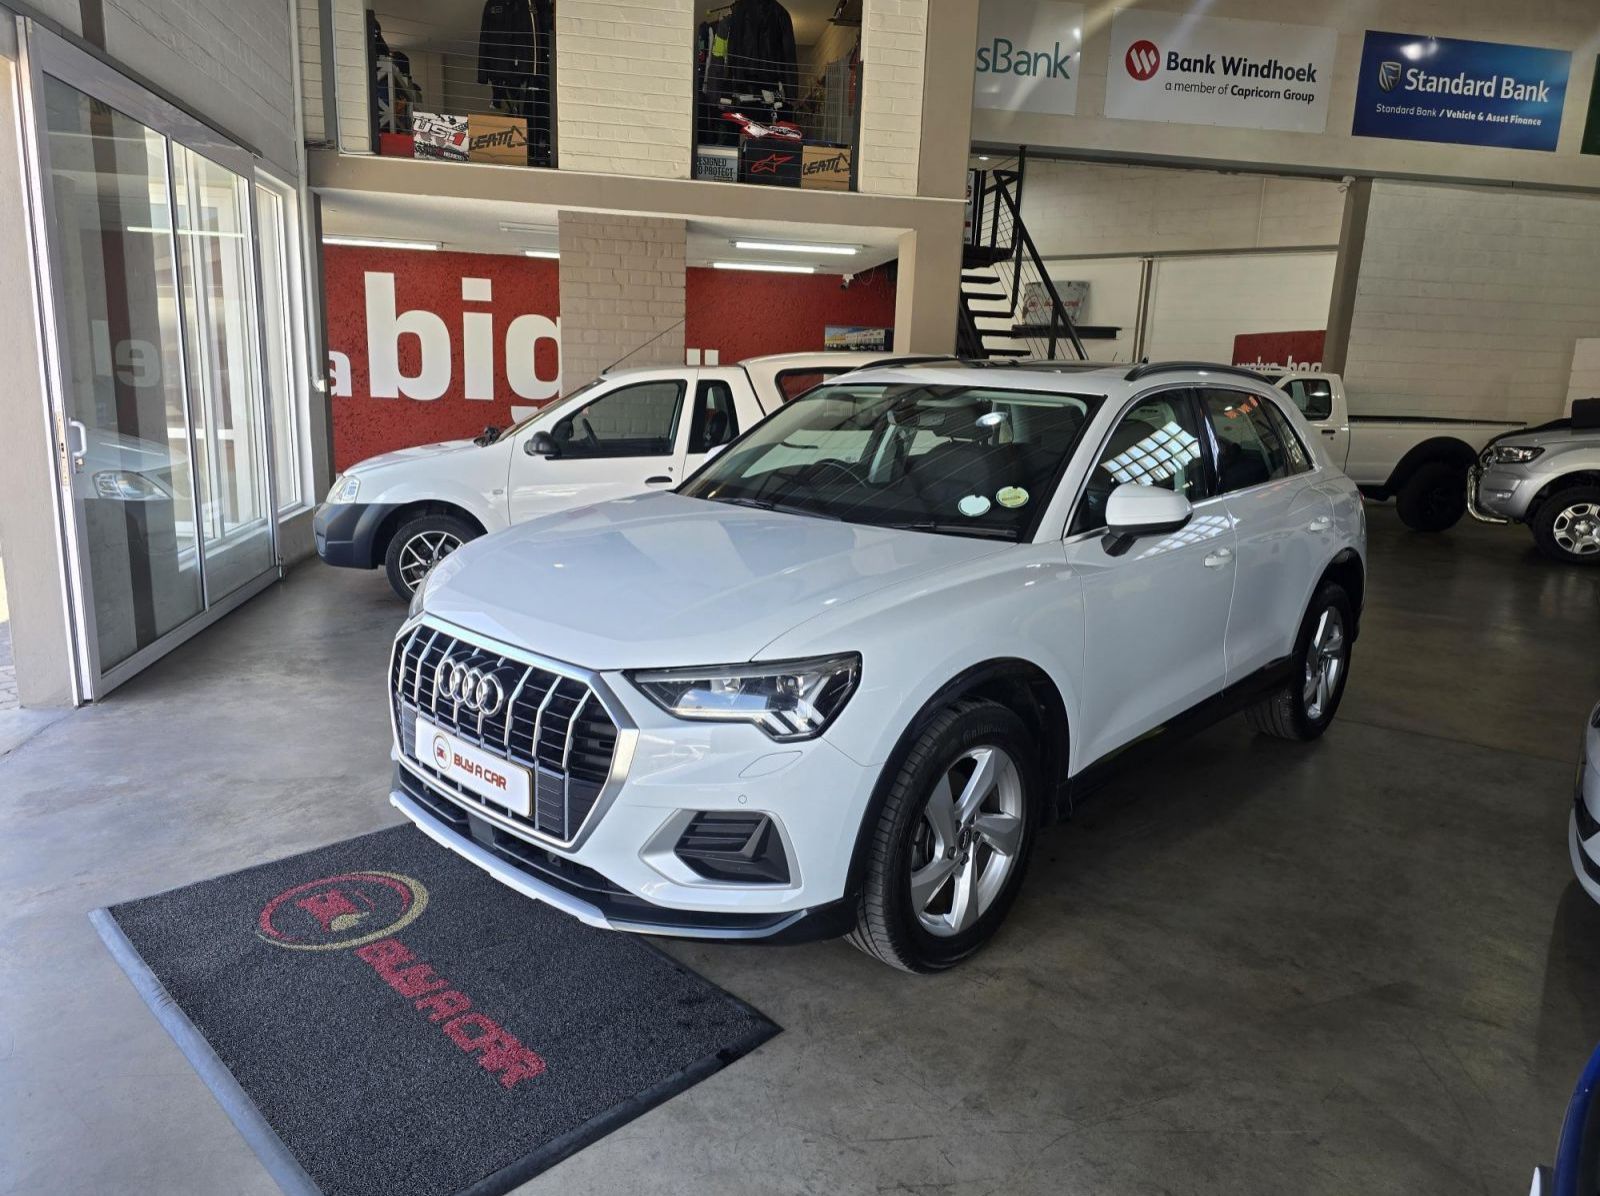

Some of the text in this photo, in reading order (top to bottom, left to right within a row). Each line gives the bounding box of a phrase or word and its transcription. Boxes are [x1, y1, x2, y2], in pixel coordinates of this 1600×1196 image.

[1166, 51, 1317, 82] Bank Windhoek
[1165, 82, 1315, 104] a member of Capricorn Group
[1405, 68, 1550, 103] Standard Bank
[1376, 104, 1414, 115] Standard
[1416, 106, 1437, 117] Bank
[1478, 113, 1484, 121] &
[1486, 113, 1508, 123] Asset
[1510, 114, 1542, 126] Finance
[704, 166, 733, 177] PROTECT
[364, 271, 562, 424] big
[453, 753, 506, 790] BUY A CAR
[353, 938, 546, 1089] BUY A CAR
